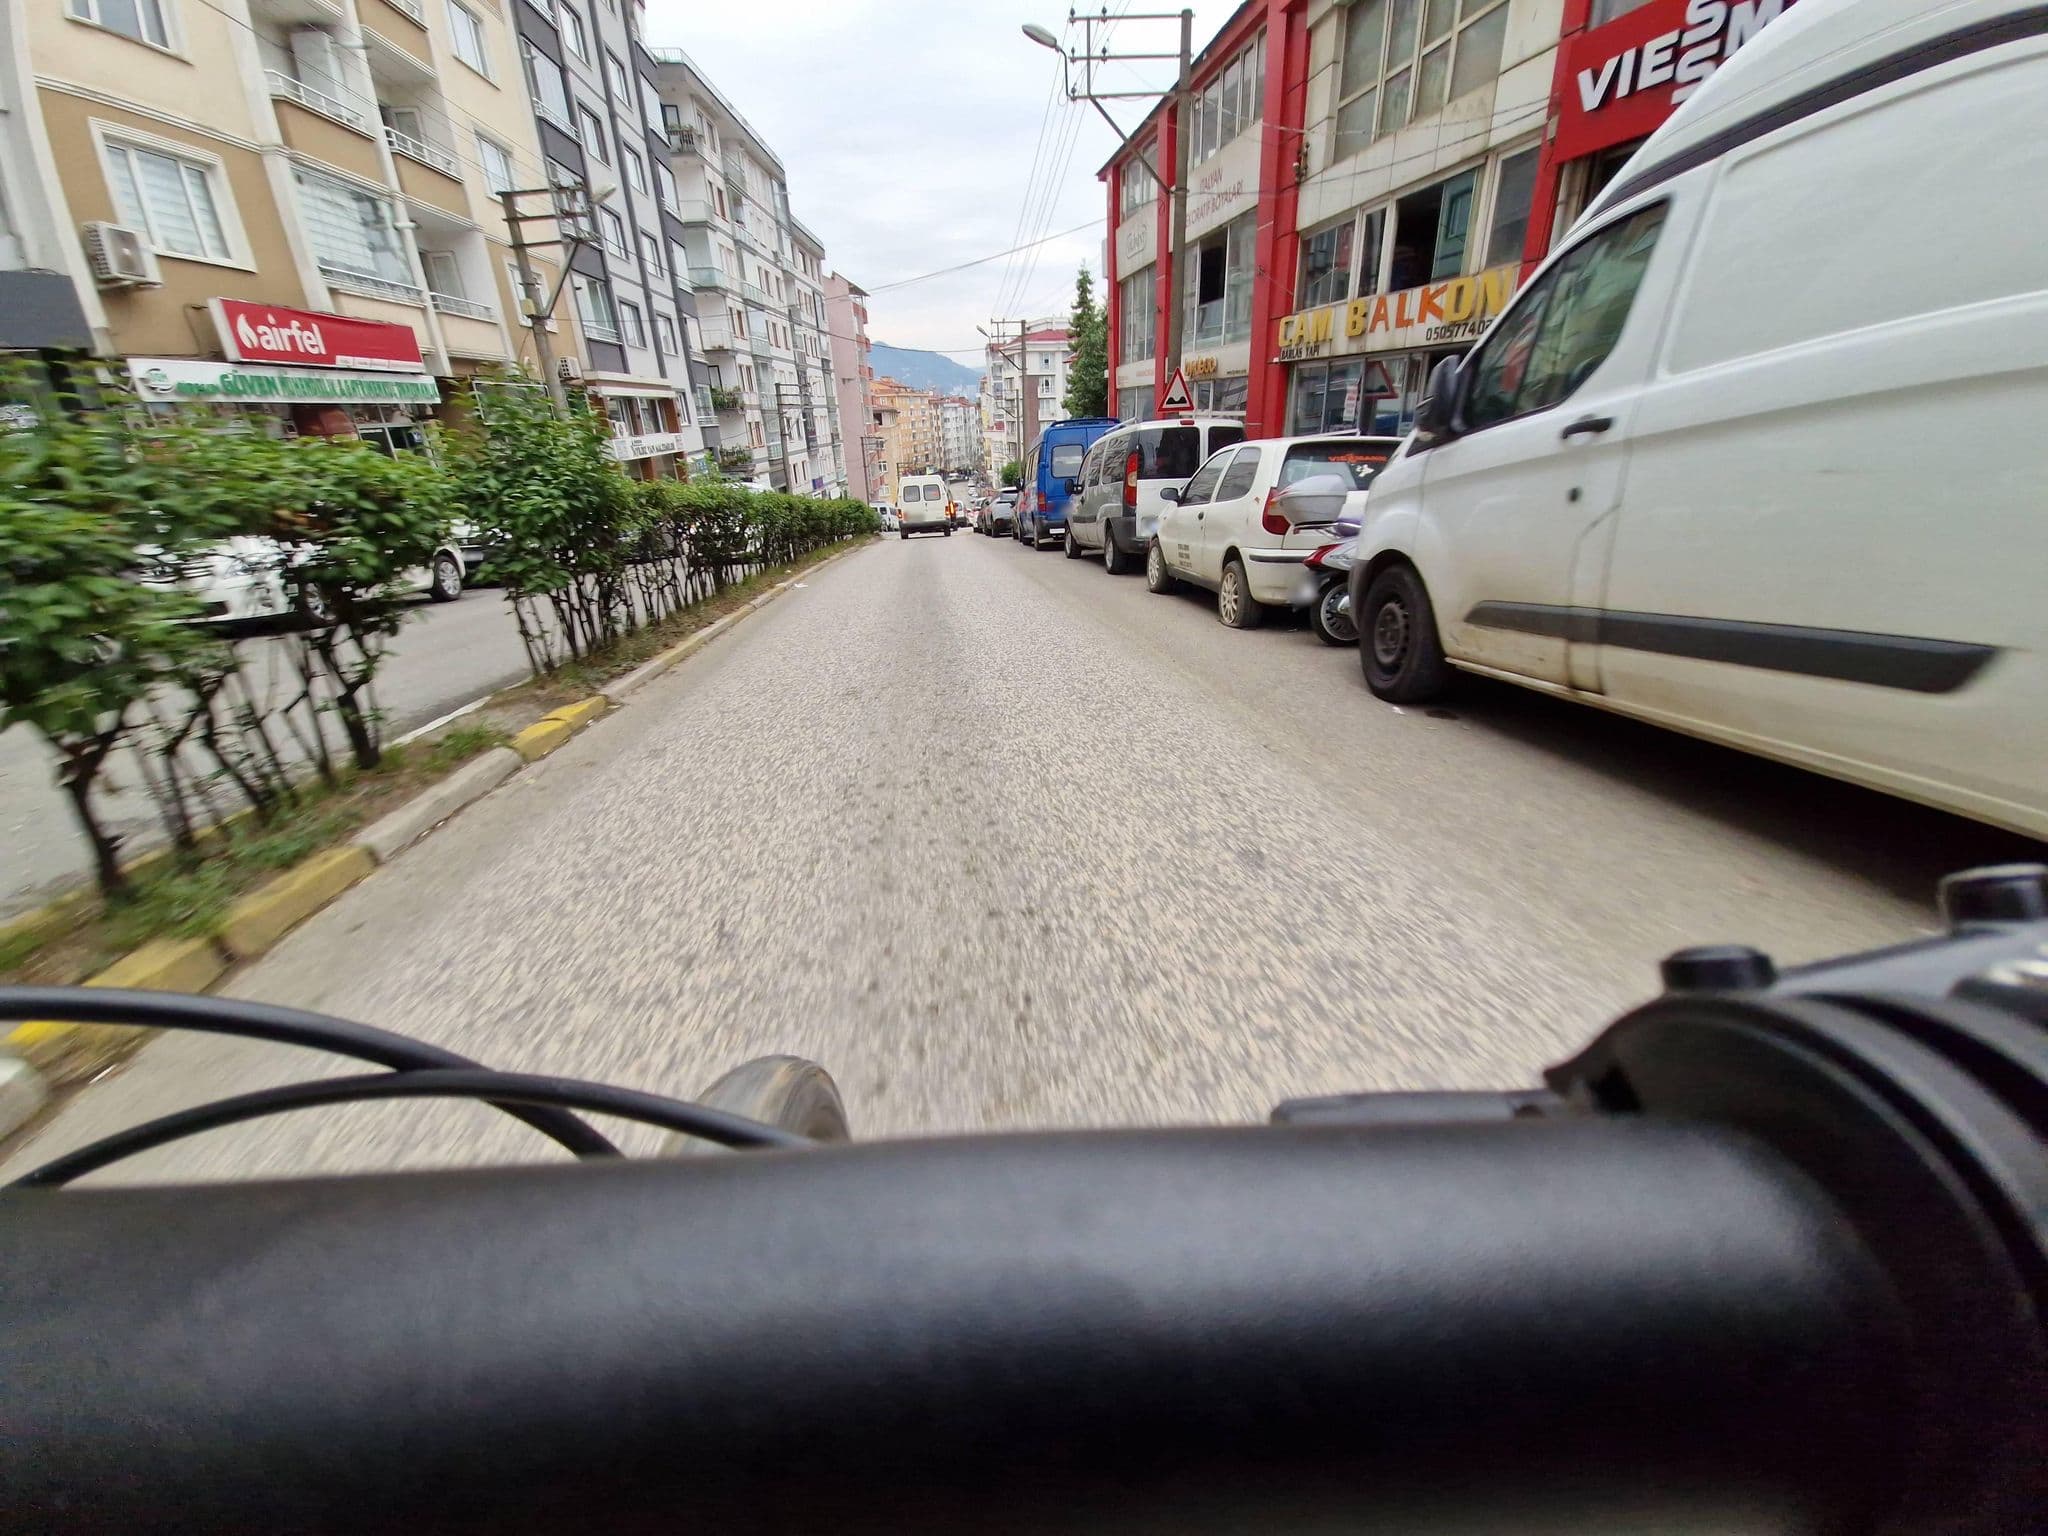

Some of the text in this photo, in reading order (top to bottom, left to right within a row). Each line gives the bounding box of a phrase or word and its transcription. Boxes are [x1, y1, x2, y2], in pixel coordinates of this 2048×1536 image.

[1278, 268, 1514, 347] CAM BALKON
[257, 313, 327, 355] airfel
[219, 369, 277, 396] GÜVEN
